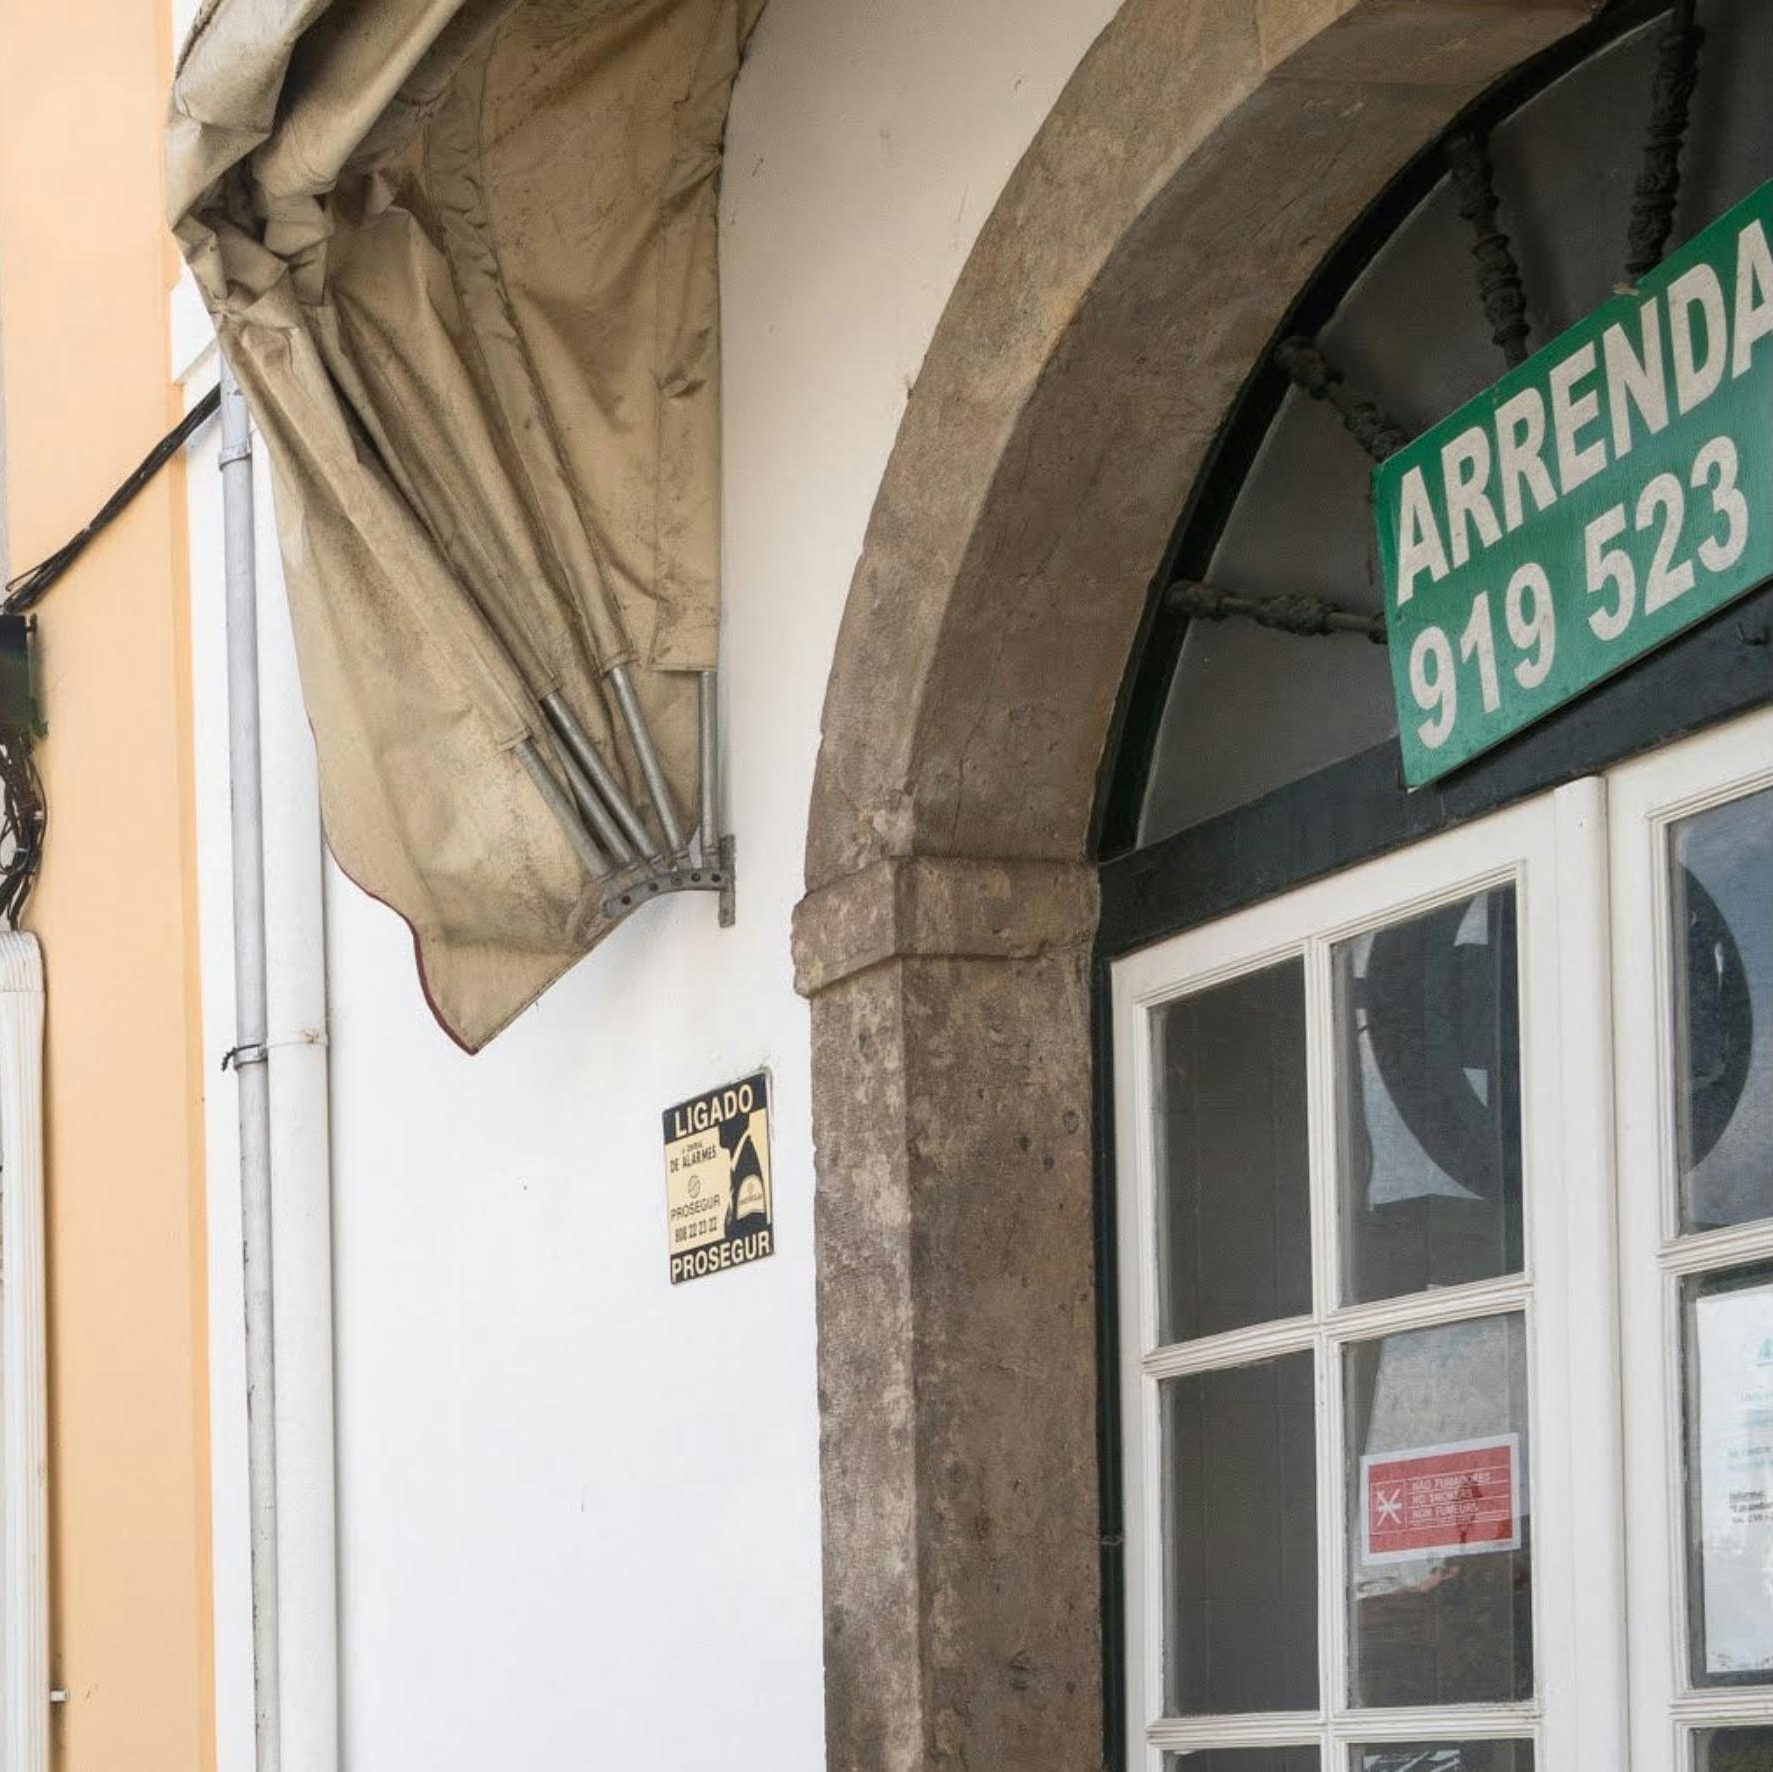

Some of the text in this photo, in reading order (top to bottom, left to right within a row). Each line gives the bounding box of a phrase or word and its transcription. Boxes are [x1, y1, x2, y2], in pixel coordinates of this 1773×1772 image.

[1397, 218, 1773, 606] ARRENDA
[1409, 435, 1749, 750] 919 523
[674, 1084, 754, 1139] LIGADO
[682, 1144, 717, 1168] ALARMES
[671, 1194, 720, 1219] PROSEGUR
[671, 1230, 770, 1284] PROSEGUR
